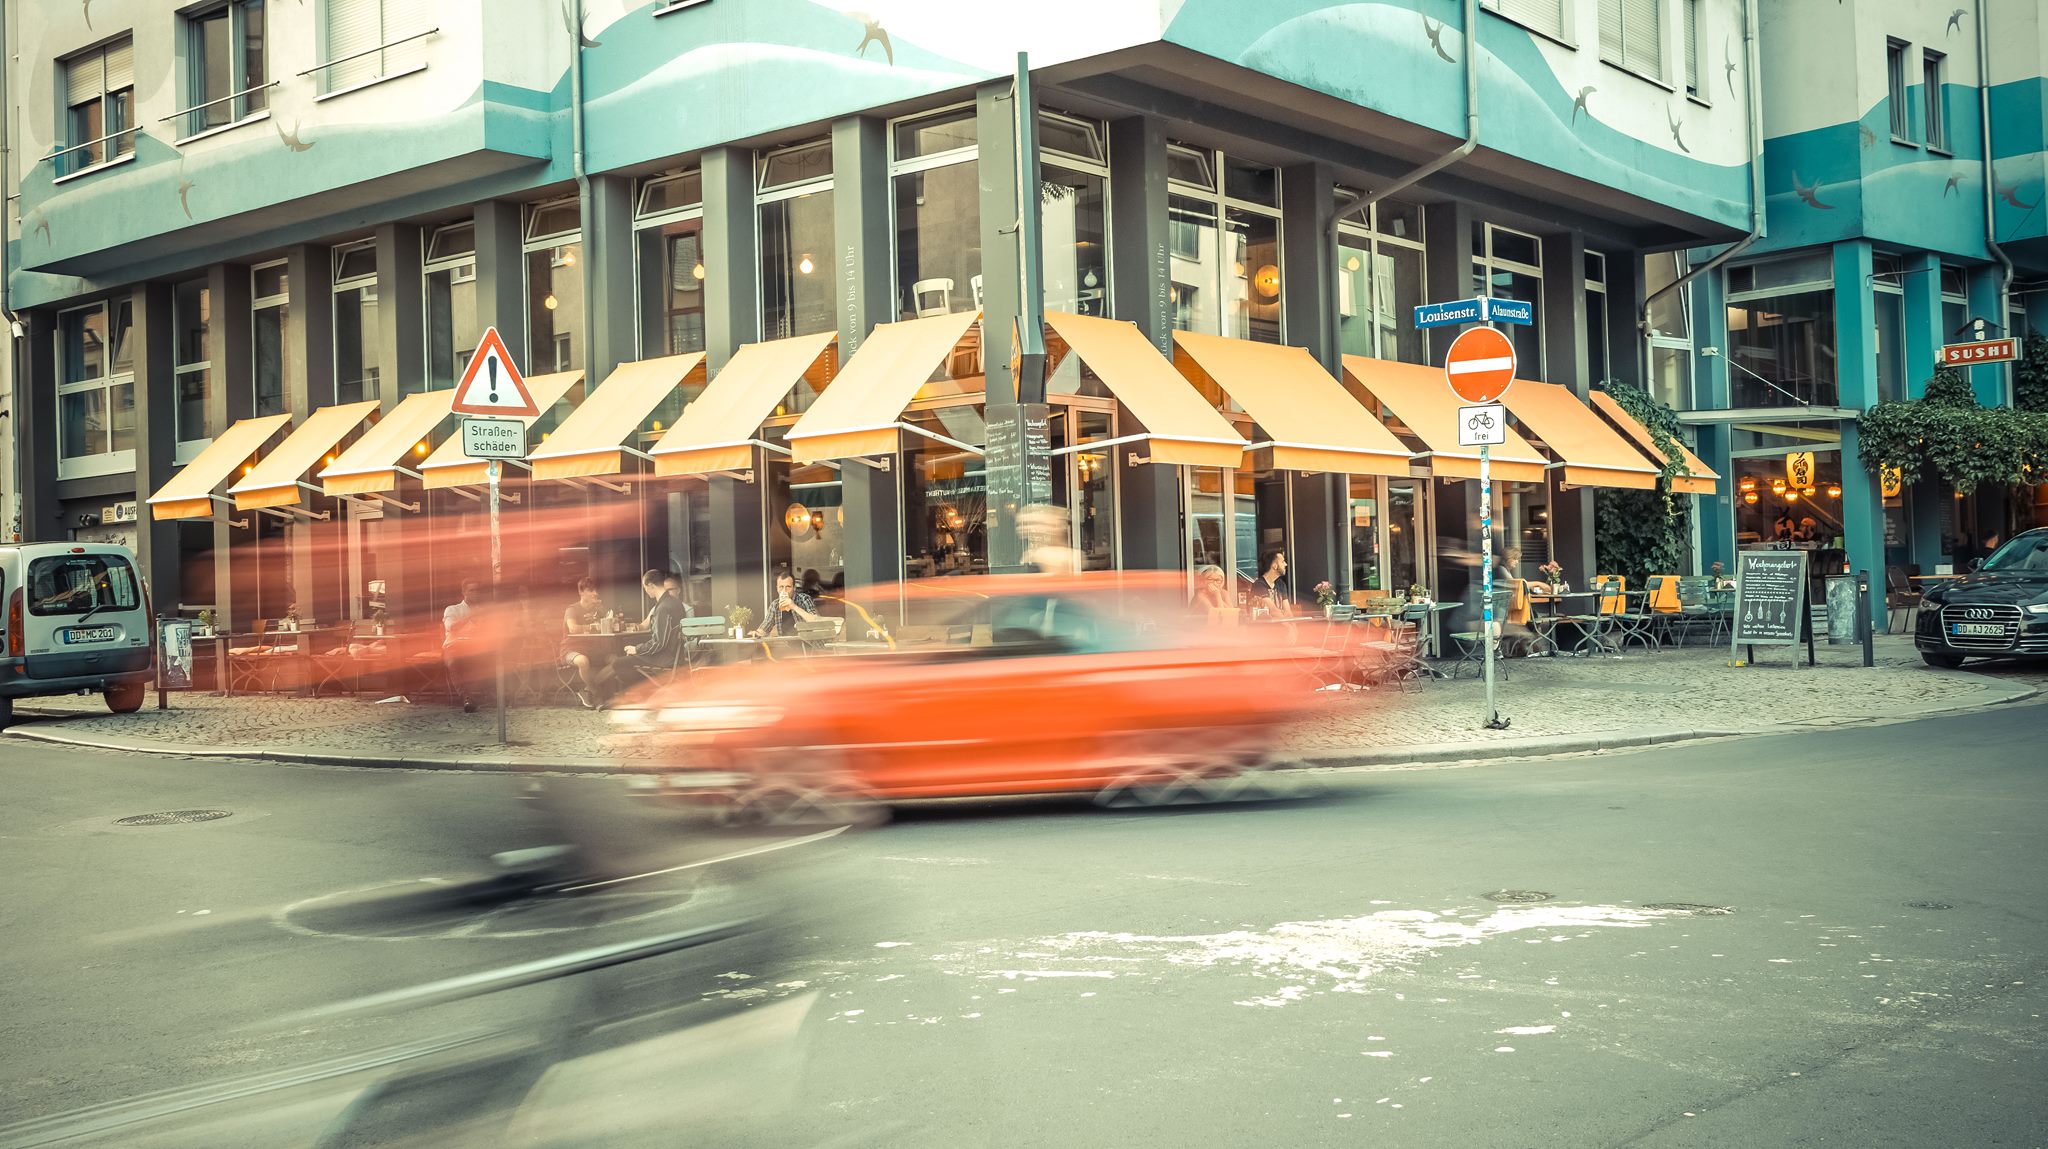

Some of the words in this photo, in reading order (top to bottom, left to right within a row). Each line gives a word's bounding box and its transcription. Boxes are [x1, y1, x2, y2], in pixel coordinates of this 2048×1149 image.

[845, 245, 855, 267] Uhr
[1157, 242, 1165, 264] Uhr
[846, 270, 855, 281] 14
[1158, 268, 1165, 278] 14
[846, 285, 856, 302] bis
[1158, 282, 1166, 298] bis
[847, 303, 857, 312] 9
[1159, 300, 1167, 308] 9
[1419, 307, 1478, 323] Louisenstr.
[1491, 304, 1529, 320] Alaunstraße
[848, 314, 857, 333] von
[1950, 345, 2009, 361] SUSHI
[471, 425, 518, 438] Straßen-
[1474, 431, 1489, 441] frei
[473, 440, 517, 452] schäden
[70, 631, 81, 640] DD
[86, 629, 97, 639] MC
[98, 629, 113, 638] 201
[1984, 625, 2004, 635] 2625
